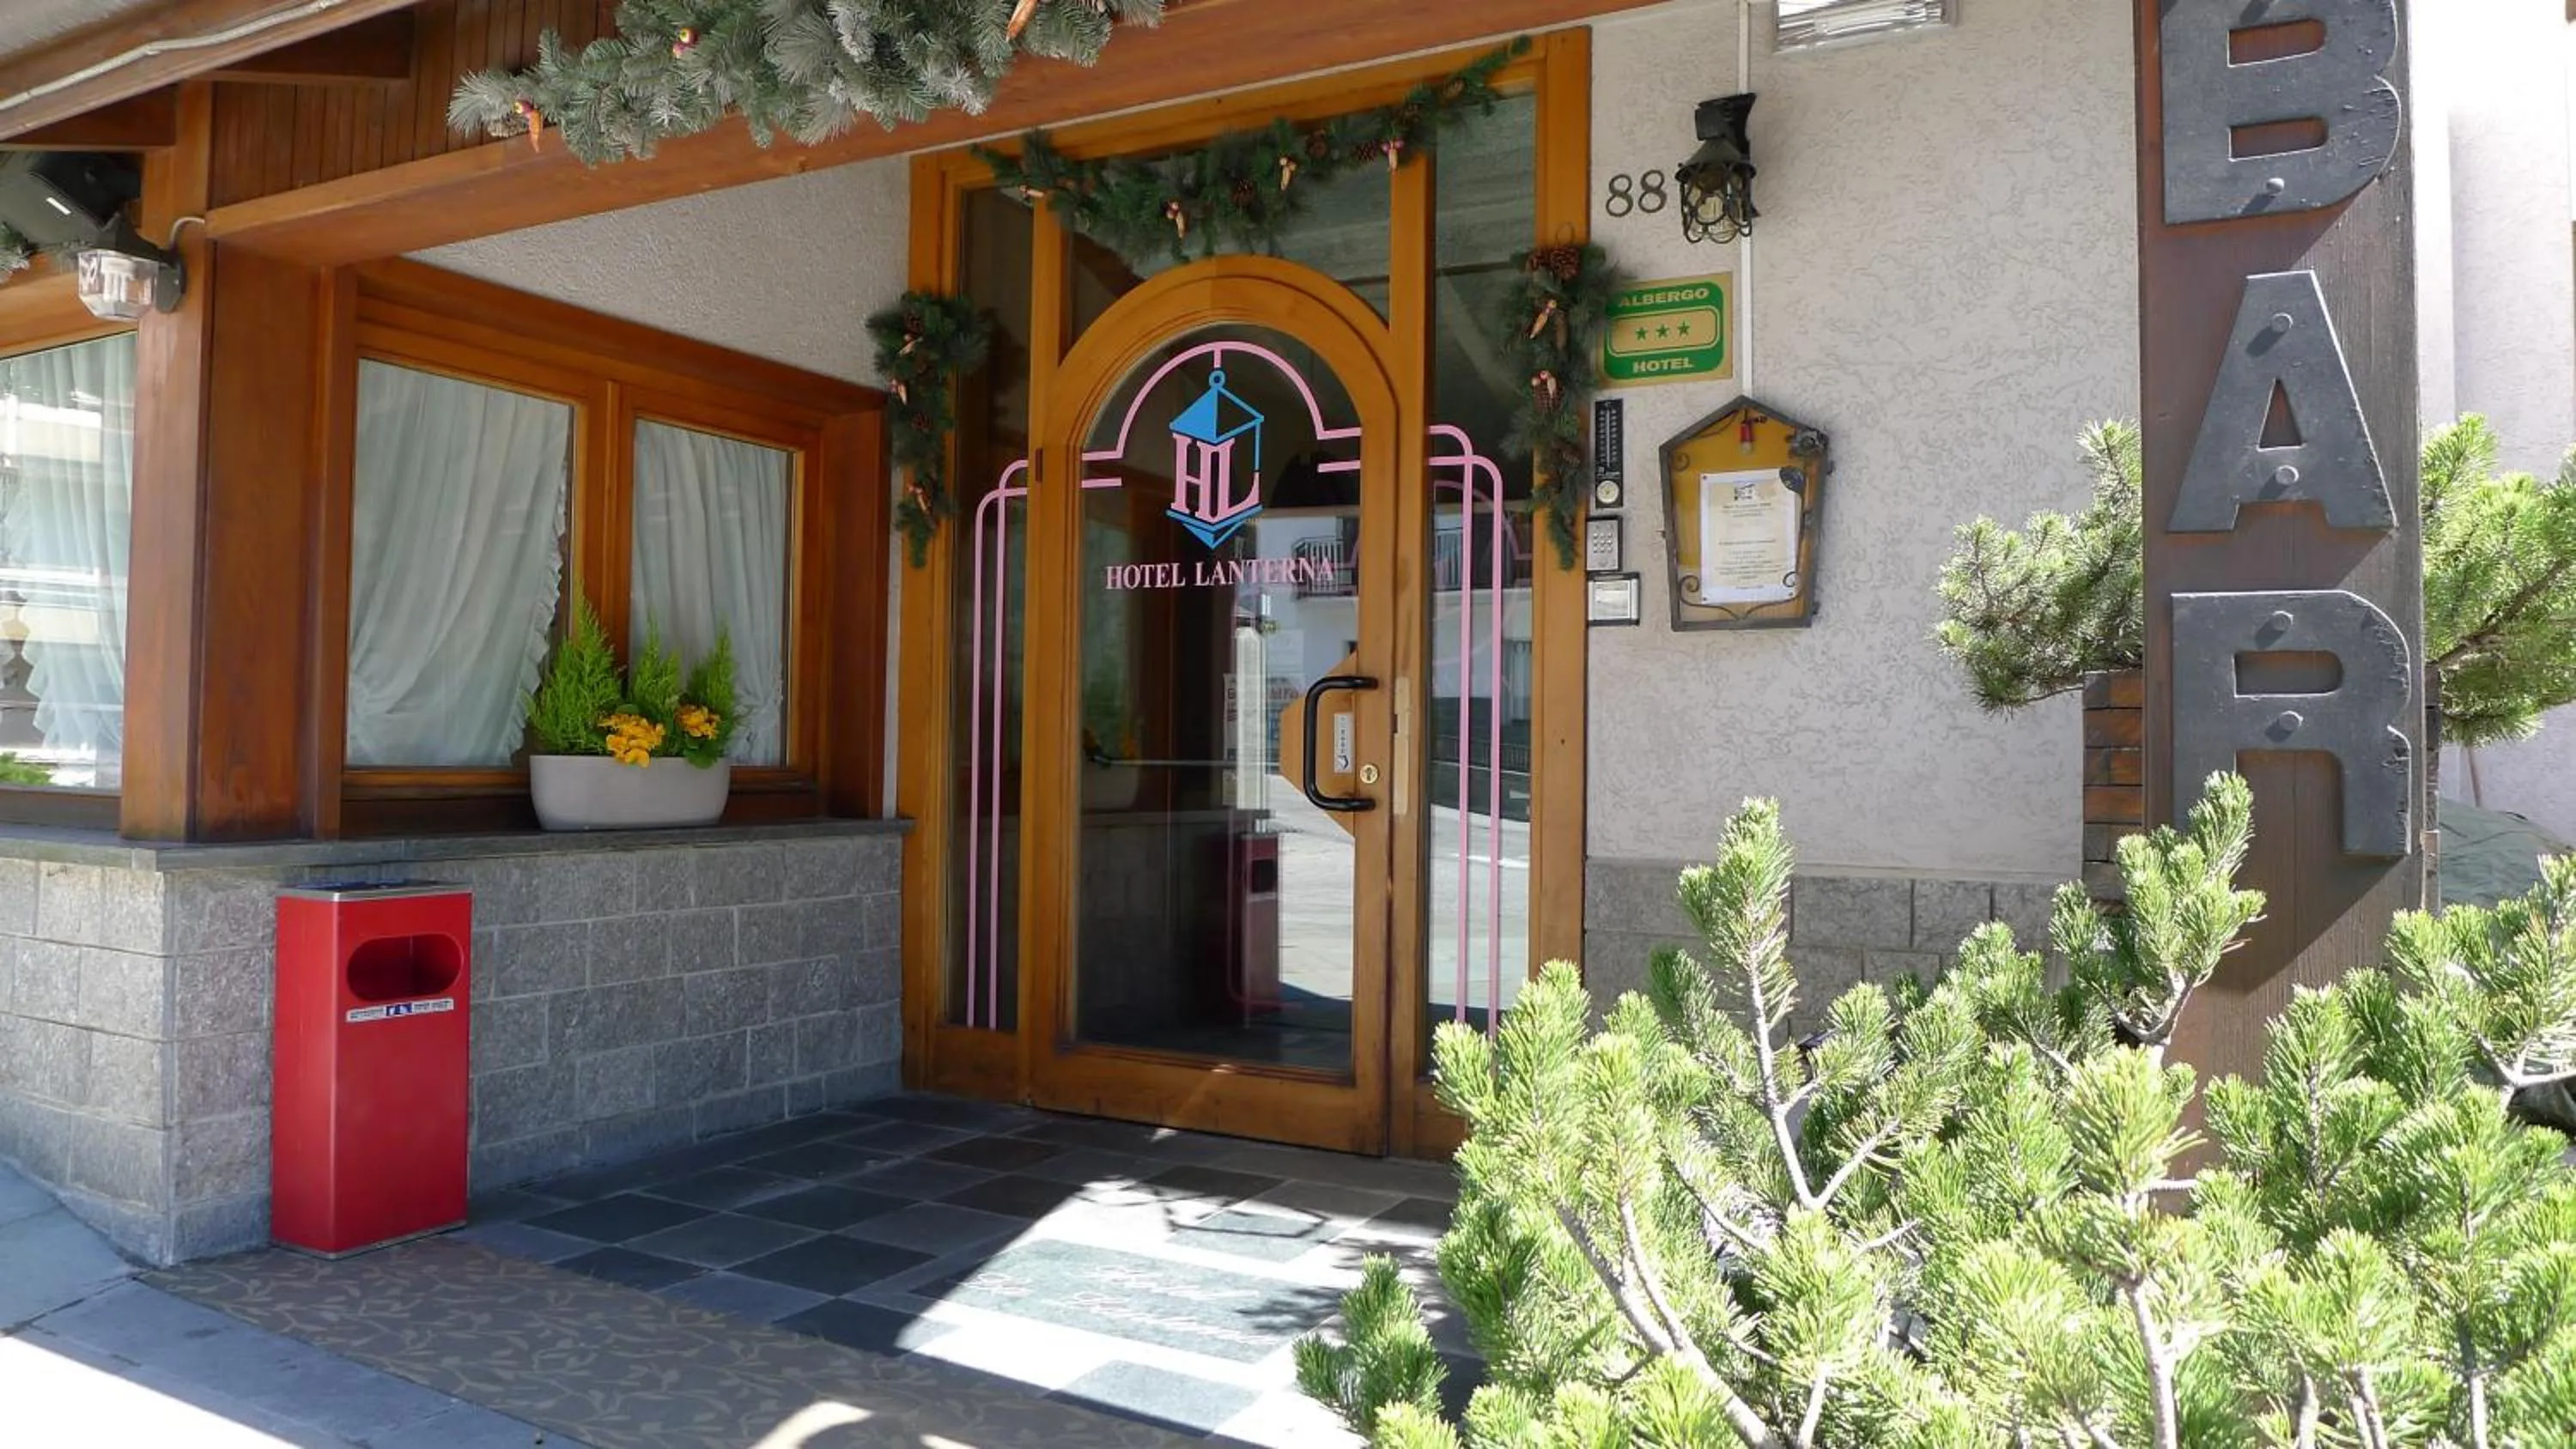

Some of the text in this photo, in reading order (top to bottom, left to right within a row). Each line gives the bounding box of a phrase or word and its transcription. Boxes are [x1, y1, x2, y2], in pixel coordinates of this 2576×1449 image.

[1606, 169, 1667, 217] 88
[1619, 288, 1710, 306] ALBERGO
[1632, 356, 1694, 373] HOTEL
[2160, 0, 2411, 857] BAR
[1170, 432, 1260, 524] HL
[1105, 556, 1334, 590] HOTEL LANTERNA
